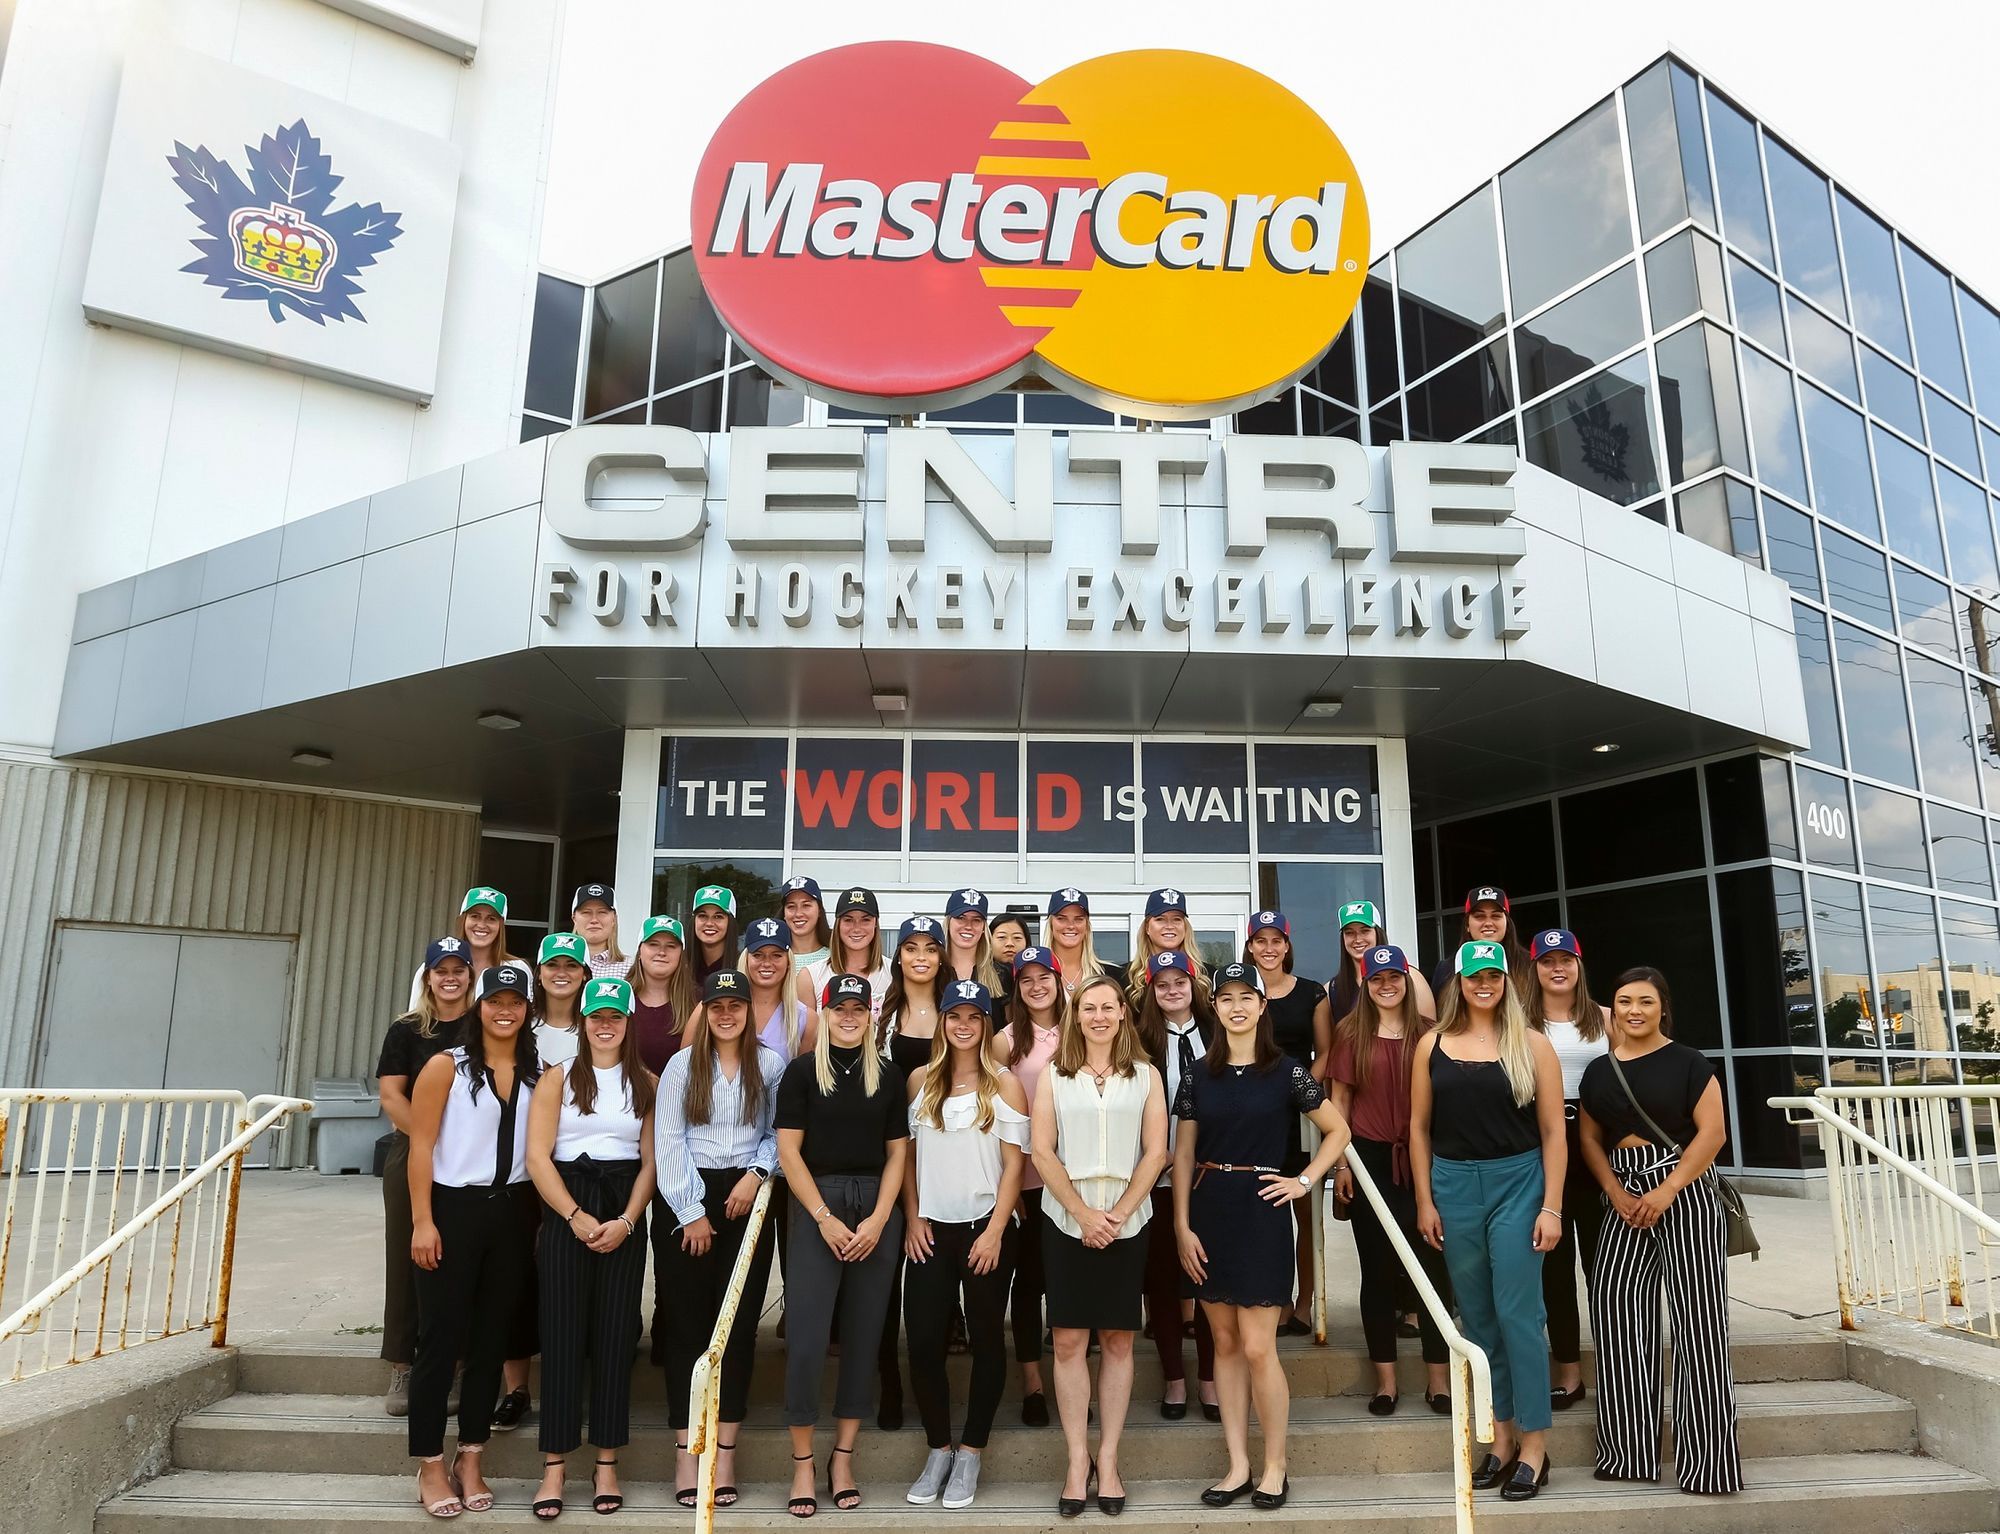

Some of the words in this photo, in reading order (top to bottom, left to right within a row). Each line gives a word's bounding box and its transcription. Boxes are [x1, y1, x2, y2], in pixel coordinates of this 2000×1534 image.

[708, 162, 1346, 274] MasterCard
[543, 424, 1526, 565] CENTRE
[539, 562, 679, 626] FOR
[725, 562, 1017, 630] HOCKEY
[1066, 567, 1531, 640] EXCELLENCE
[678, 780, 767, 817] THE
[780, 769, 1082, 832] WORLD
[1103, 785, 1147, 822] IS
[1160, 786, 1361, 823] WAITING
[1807, 801, 1846, 840] 400
